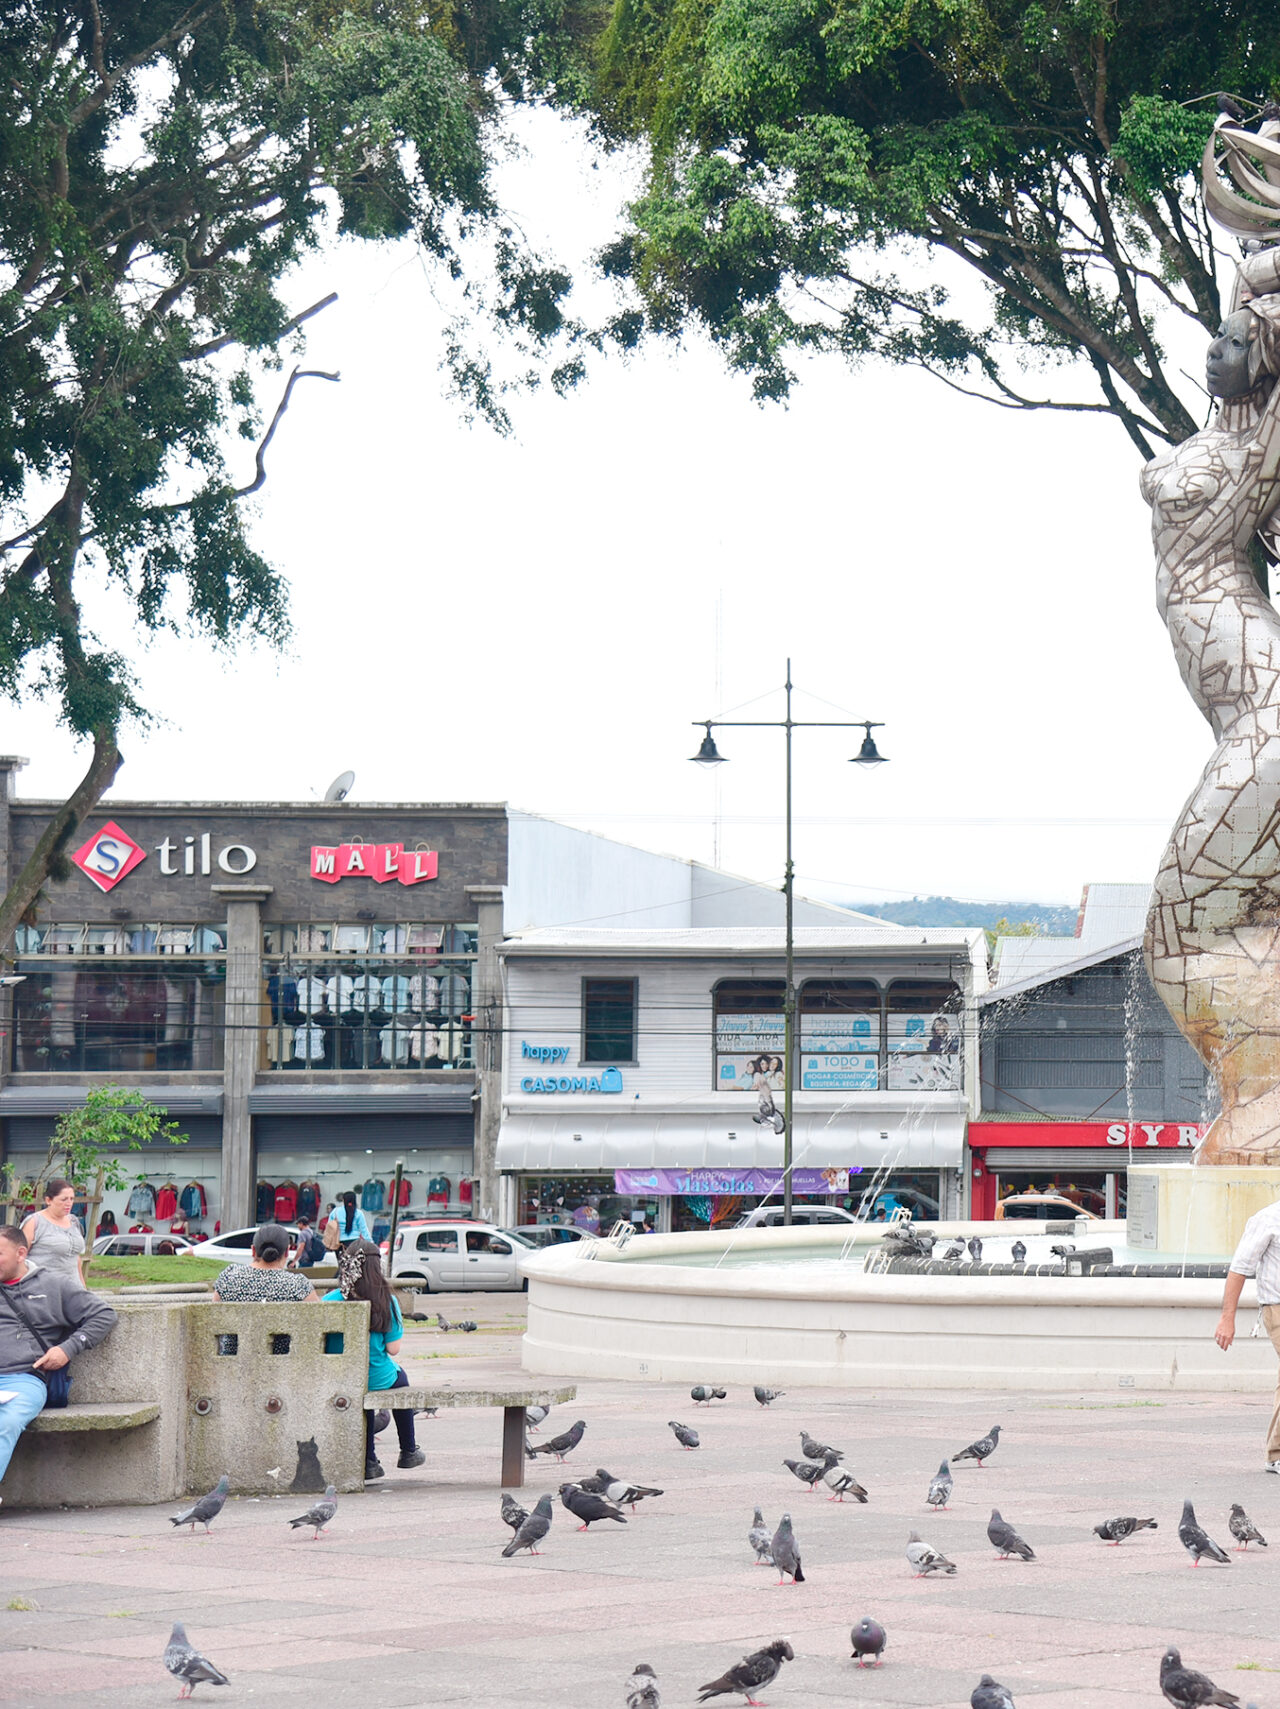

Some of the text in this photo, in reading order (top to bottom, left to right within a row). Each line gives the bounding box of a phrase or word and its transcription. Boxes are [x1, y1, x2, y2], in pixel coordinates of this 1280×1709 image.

[315, 845, 428, 880] MALL
[521, 1040, 570, 1065] happy
[824, 1056, 860, 1067] TODO
[520, 1076, 600, 1093] CASOMA
